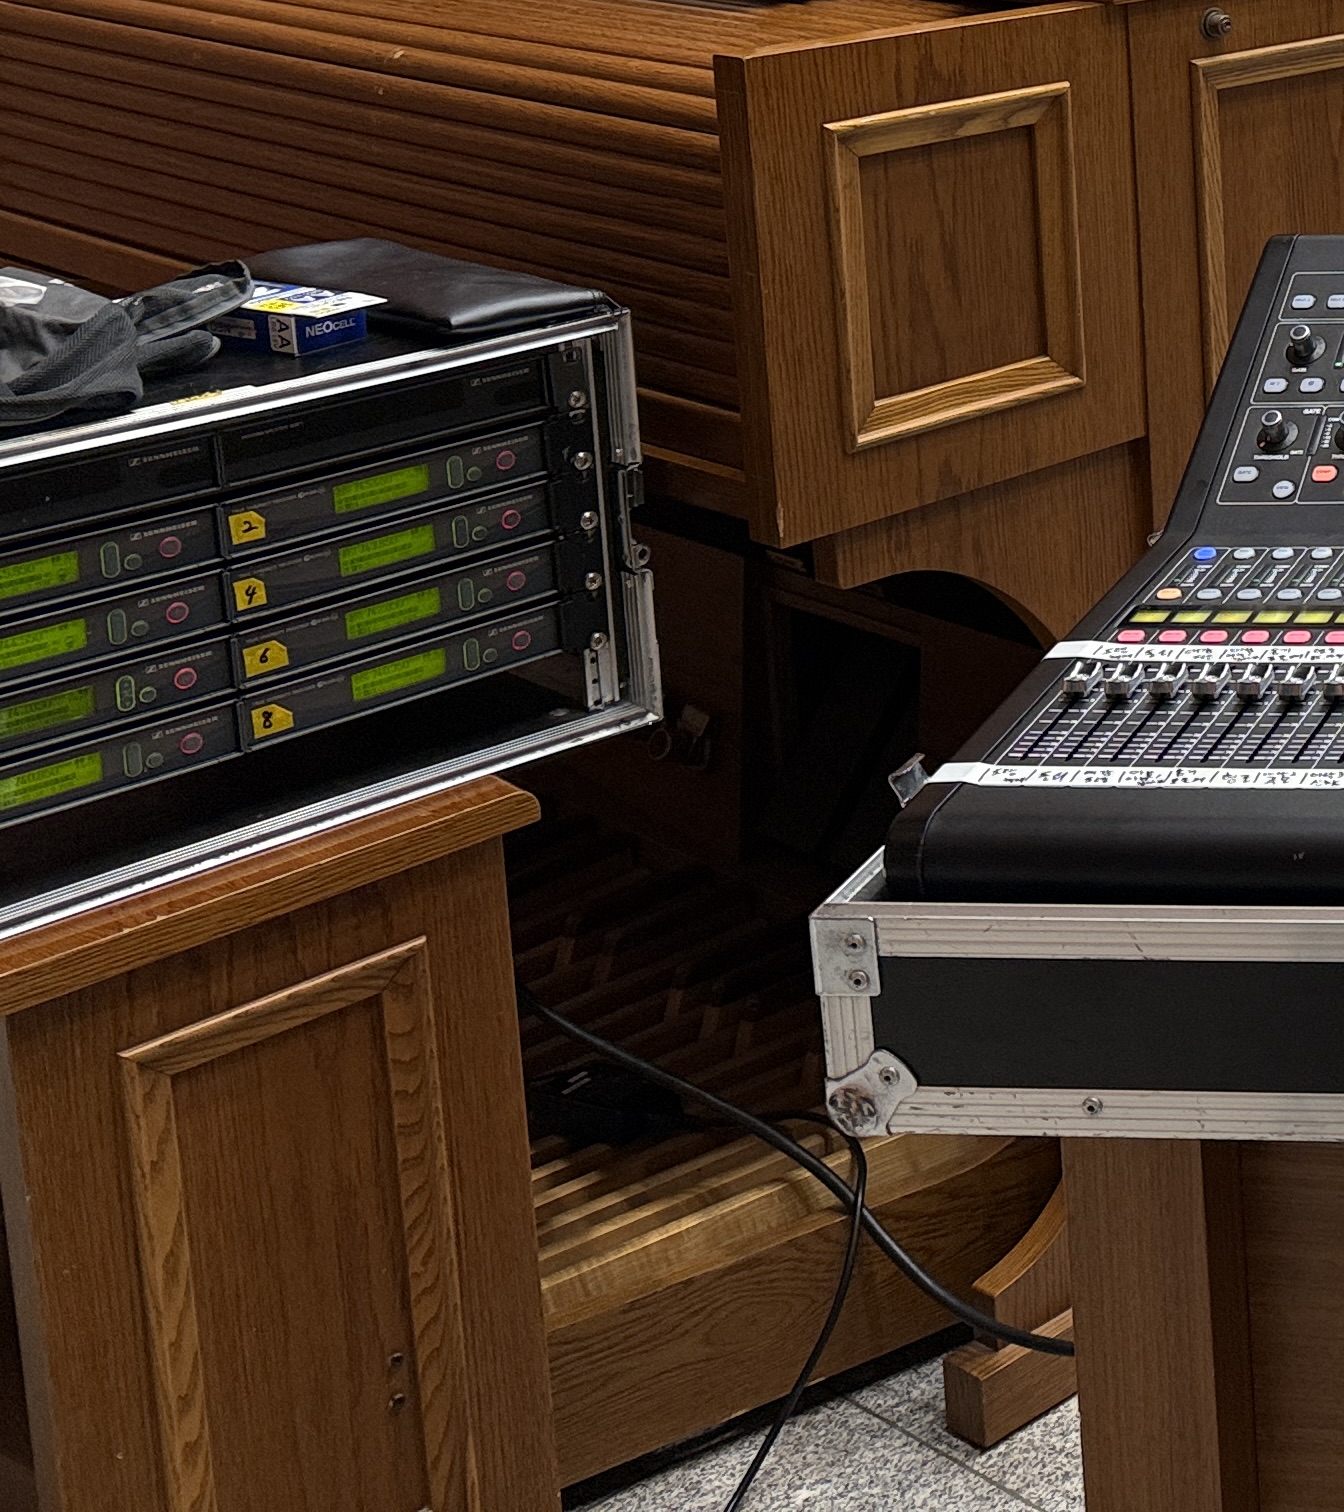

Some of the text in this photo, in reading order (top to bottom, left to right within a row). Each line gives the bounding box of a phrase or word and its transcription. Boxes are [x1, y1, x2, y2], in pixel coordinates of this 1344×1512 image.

[306, 318, 356, 339] NEOCELL
[243, 520, 260, 533] 2
[244, 584, 257, 605] 4
[258, 645, 270, 665] 6
[261, 711, 274, 730] 8
